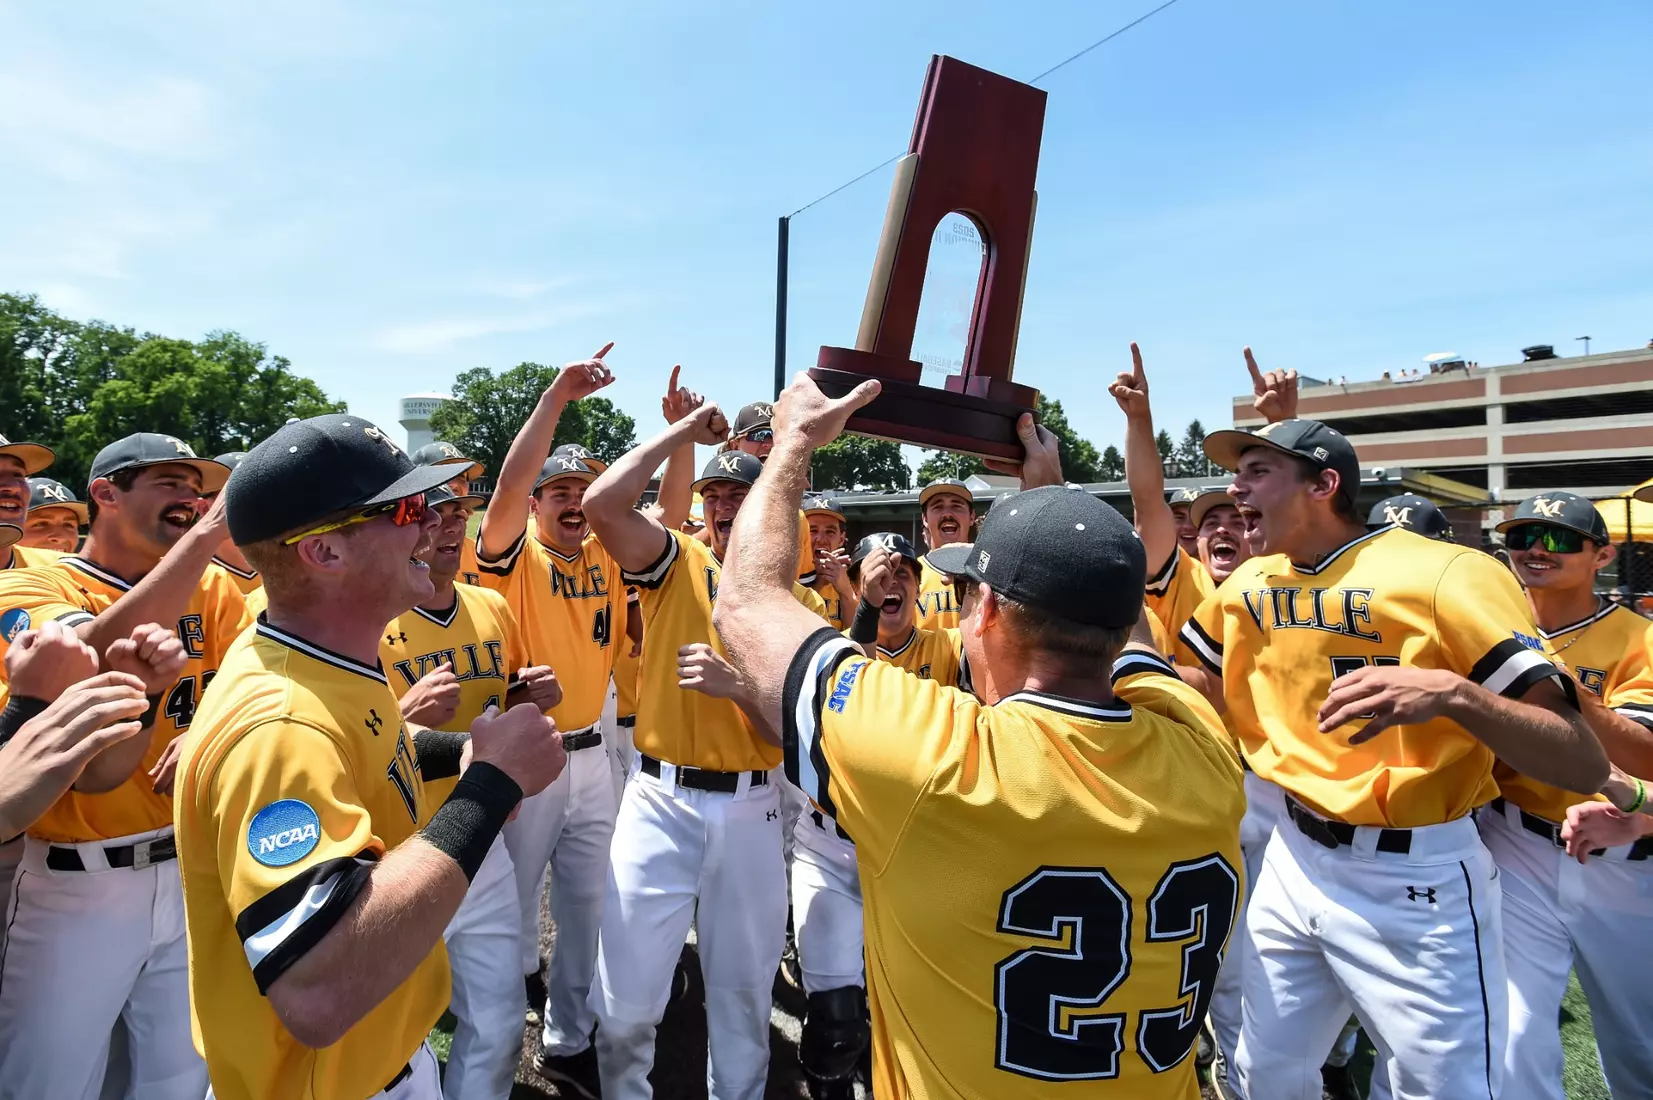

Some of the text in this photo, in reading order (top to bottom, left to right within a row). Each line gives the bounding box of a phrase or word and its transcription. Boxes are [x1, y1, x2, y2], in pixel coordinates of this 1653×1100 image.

[718, 454, 742, 474] M
[1383, 506, 1413, 528] M
[1532, 496, 1566, 518] M
[547, 562, 608, 600] VILLE
[916, 591, 962, 621] VIL
[1241, 587, 1383, 643] VILLE
[1512, 629, 1545, 653] PSAC
[393, 640, 505, 688] VILLE
[828, 662, 867, 714] PSAC
[259, 822, 318, 855] NCAA
[994, 852, 1239, 1082] 23
